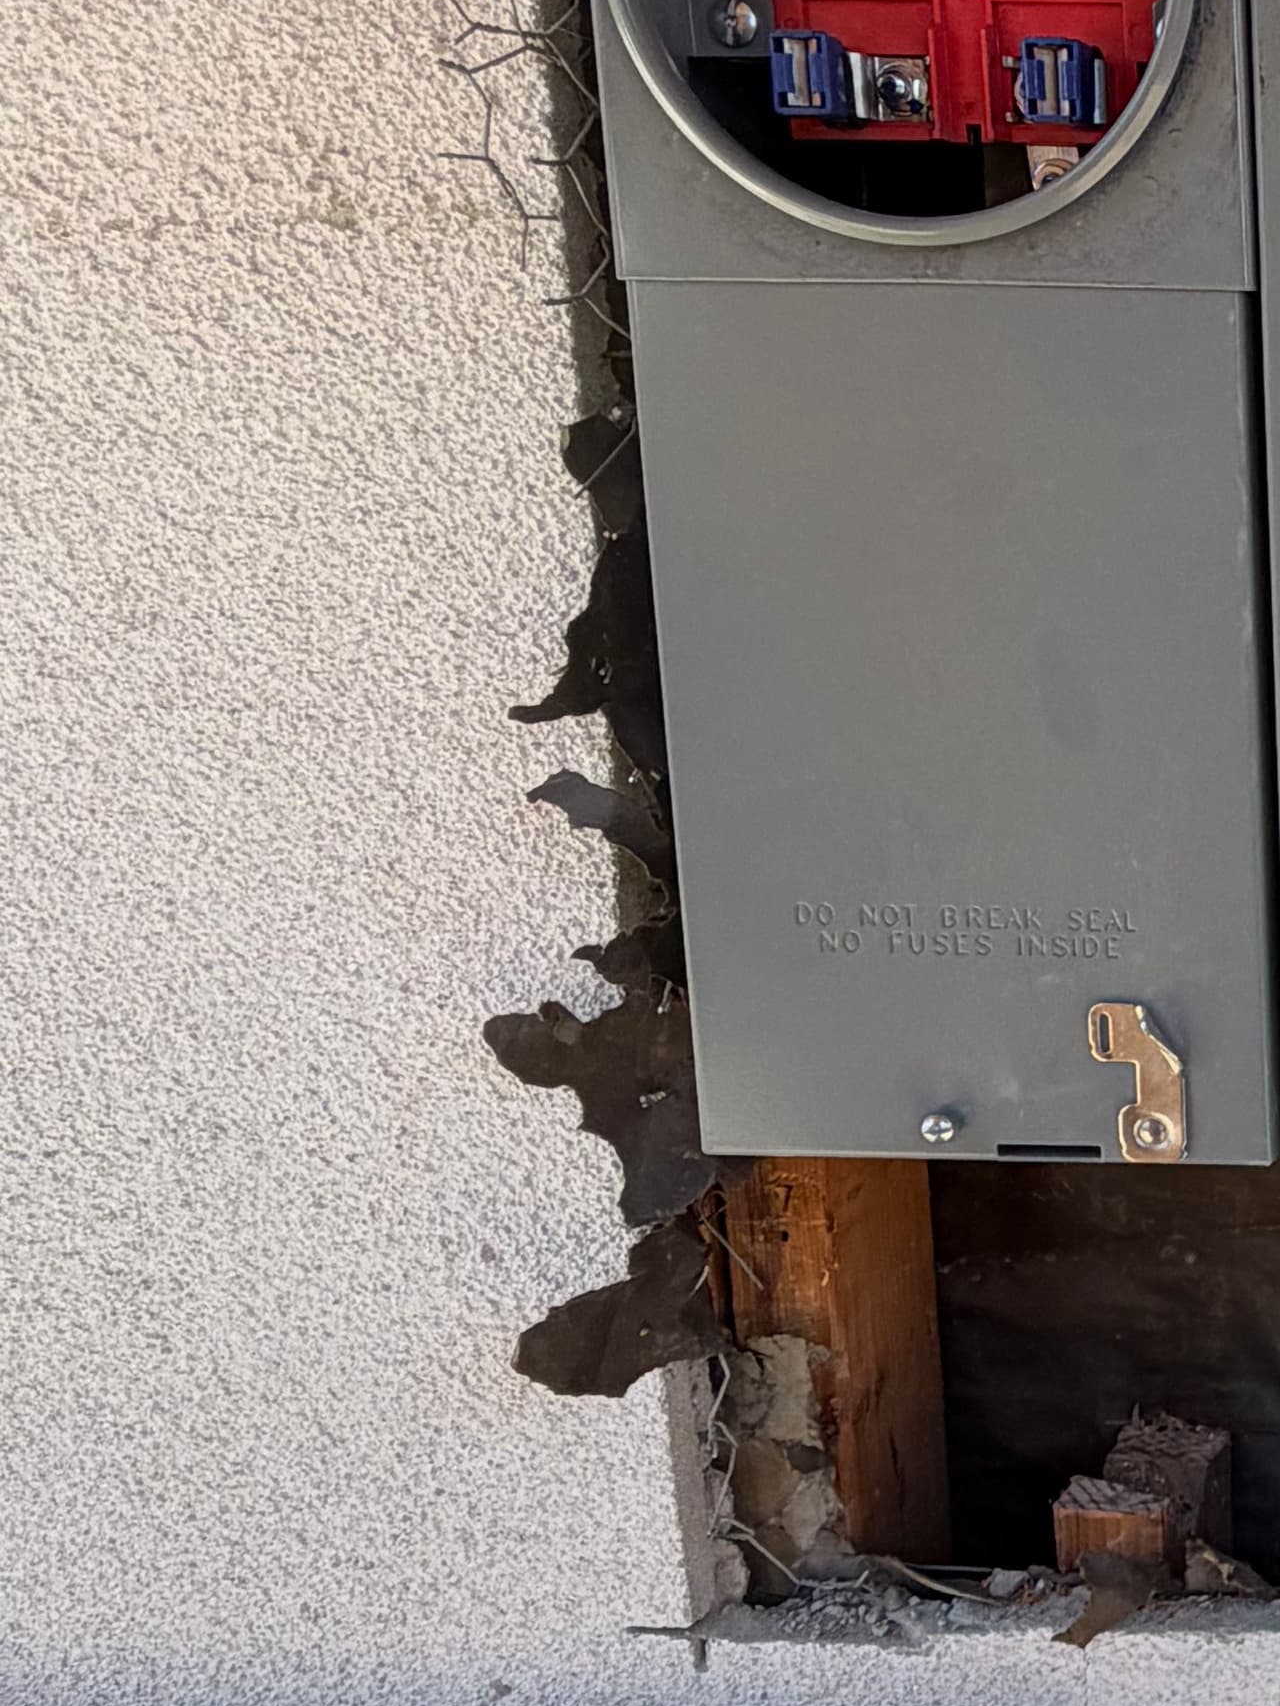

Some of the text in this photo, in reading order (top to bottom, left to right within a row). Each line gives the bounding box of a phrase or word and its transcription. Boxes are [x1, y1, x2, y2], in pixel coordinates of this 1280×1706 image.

[794, 900, 1138, 933] DO NOT BREAK SEAL
[819, 929, 1121, 959] NO FUSES INSIDE
